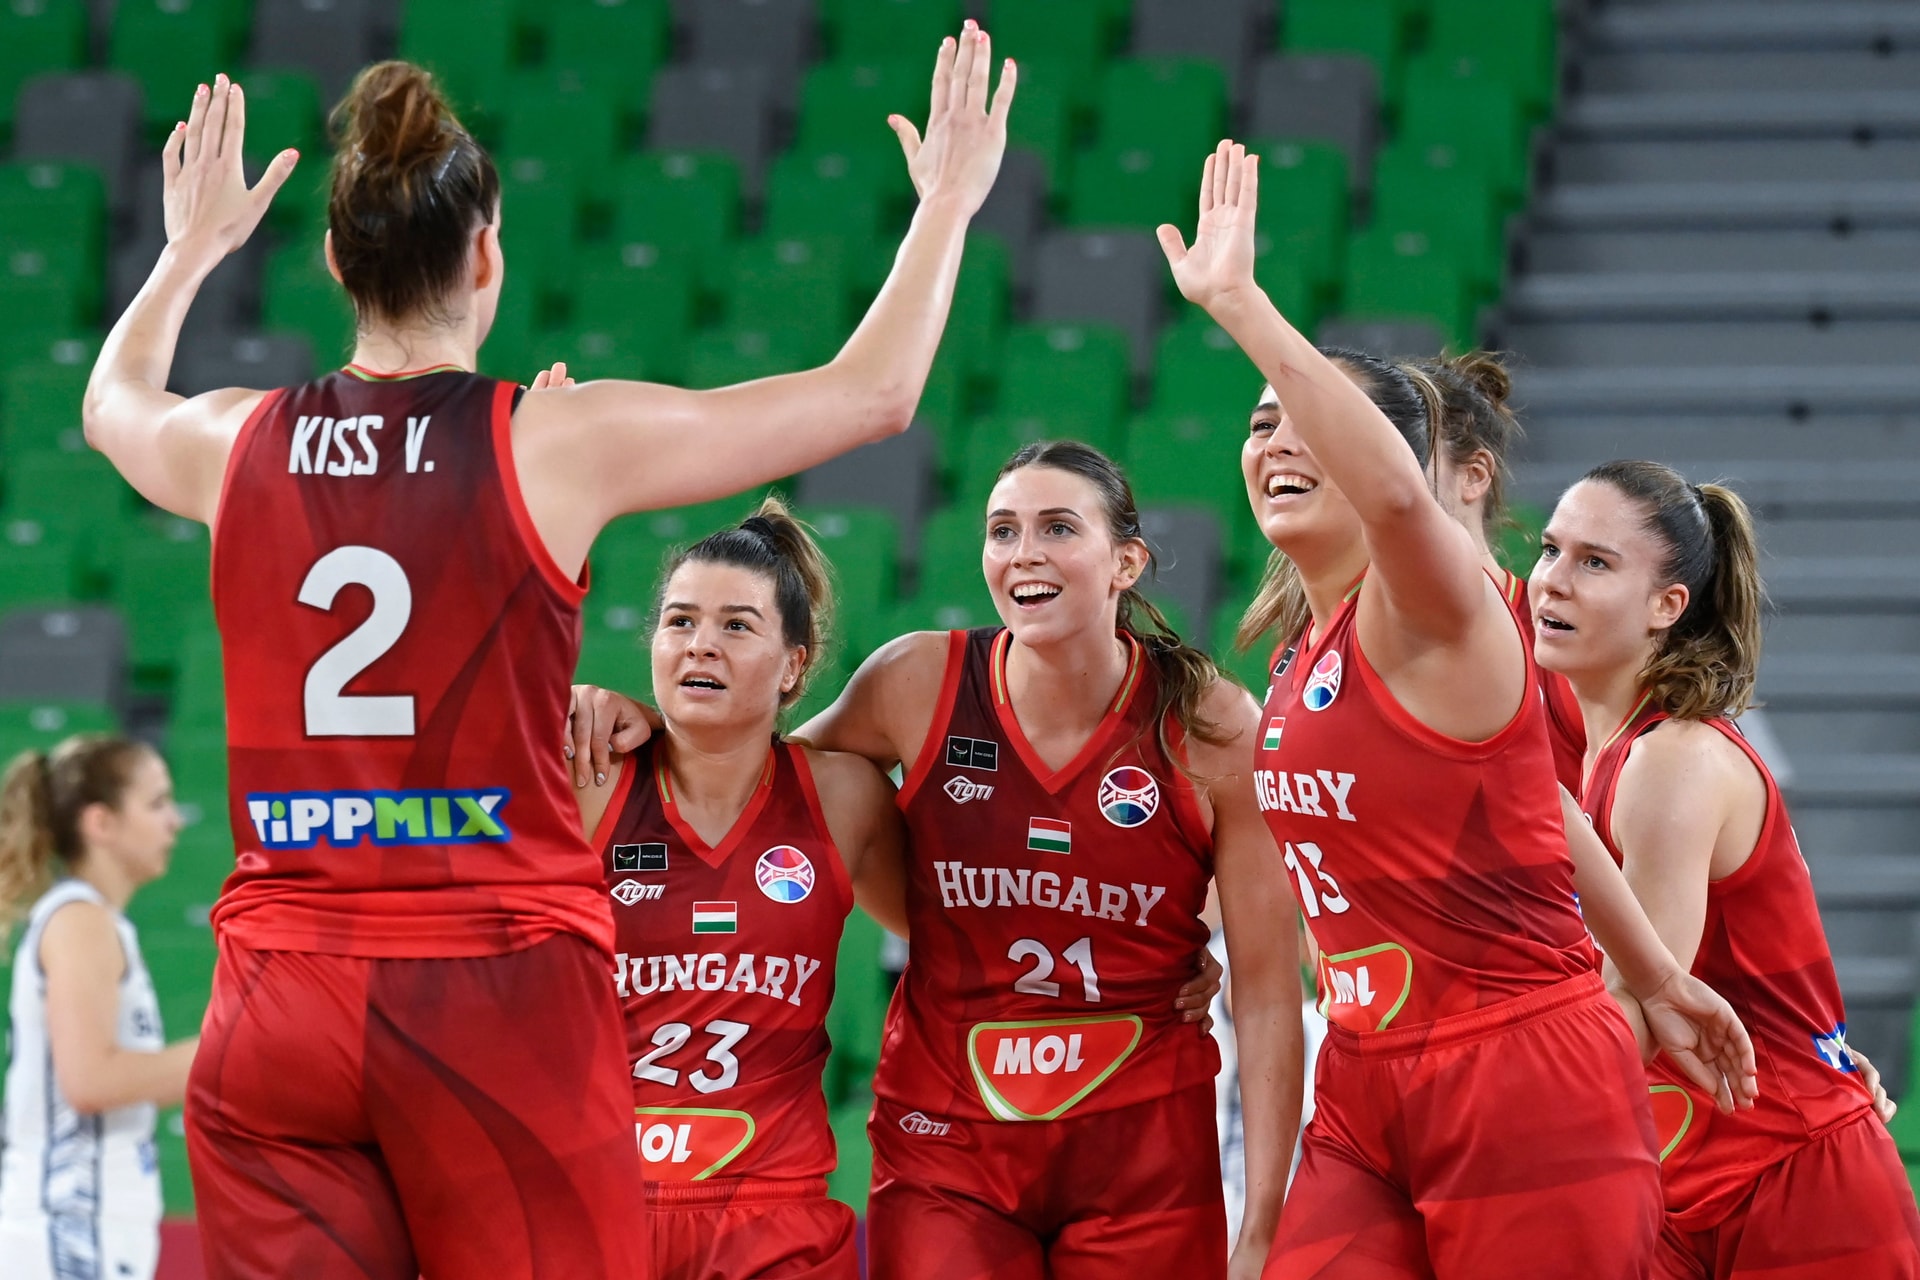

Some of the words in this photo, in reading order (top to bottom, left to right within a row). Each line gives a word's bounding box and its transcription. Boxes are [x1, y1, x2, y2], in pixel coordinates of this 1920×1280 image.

[288, 415, 383, 477] KISS
[404, 415, 435, 474] V.
[298, 545, 415, 736] 2
[1254, 769, 1357, 822] NGARY
[933, 861, 1166, 926] HUNGARY
[1284, 841, 1350, 918] 13
[1007, 937, 1101, 1003] 21
[632, 1019, 750, 1094] 23
[993, 1033, 1085, 1075] MOL
[634, 1122, 693, 1163] OL
